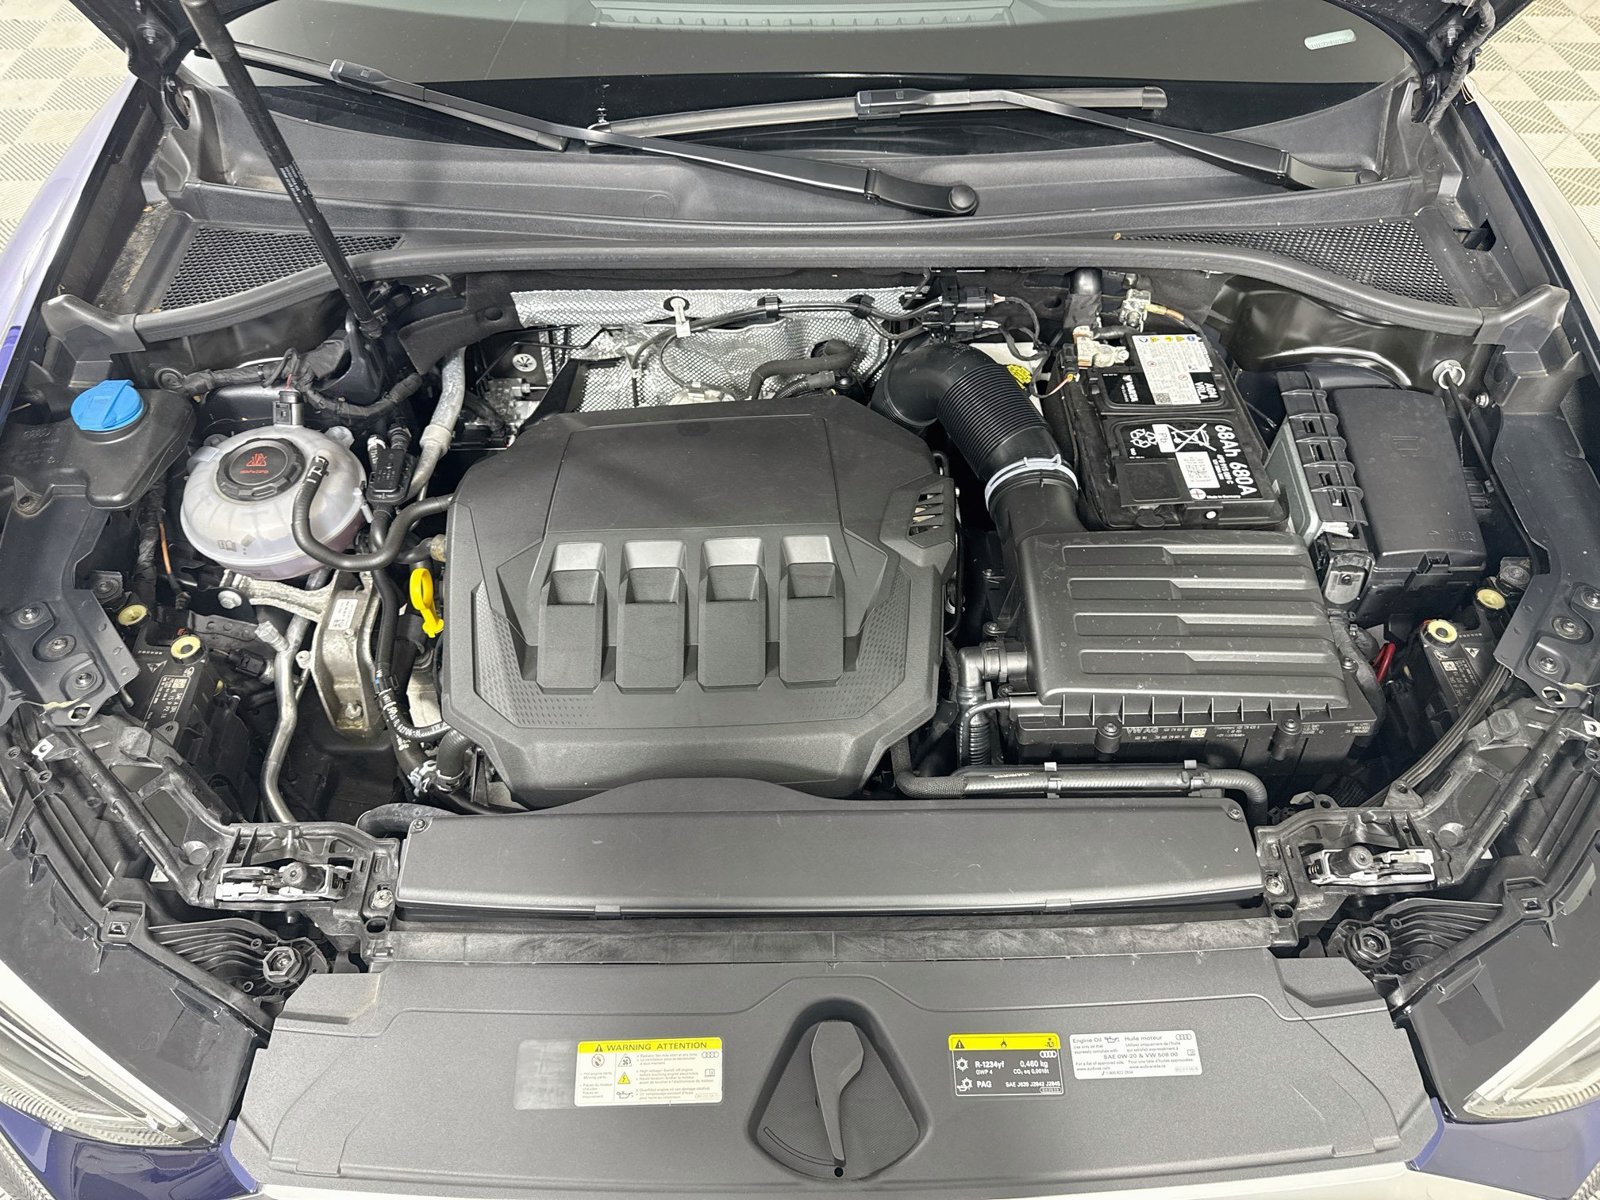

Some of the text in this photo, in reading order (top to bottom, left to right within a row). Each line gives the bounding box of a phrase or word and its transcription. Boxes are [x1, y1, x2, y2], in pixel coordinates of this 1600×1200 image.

[1126, 377, 1139, 403] VARTA
[1195, 381, 1208, 400] VRLA
[1204, 382, 1219, 398] AGM
[1215, 424, 1241, 458] 68Ah
[1229, 461, 1258, 496] 680A
[606, 1042, 707, 1051] WARNING ATTENTION
[974, 1060, 1005, 1070] R-1234yf
[1040, 1060, 1048, 1069] kg
